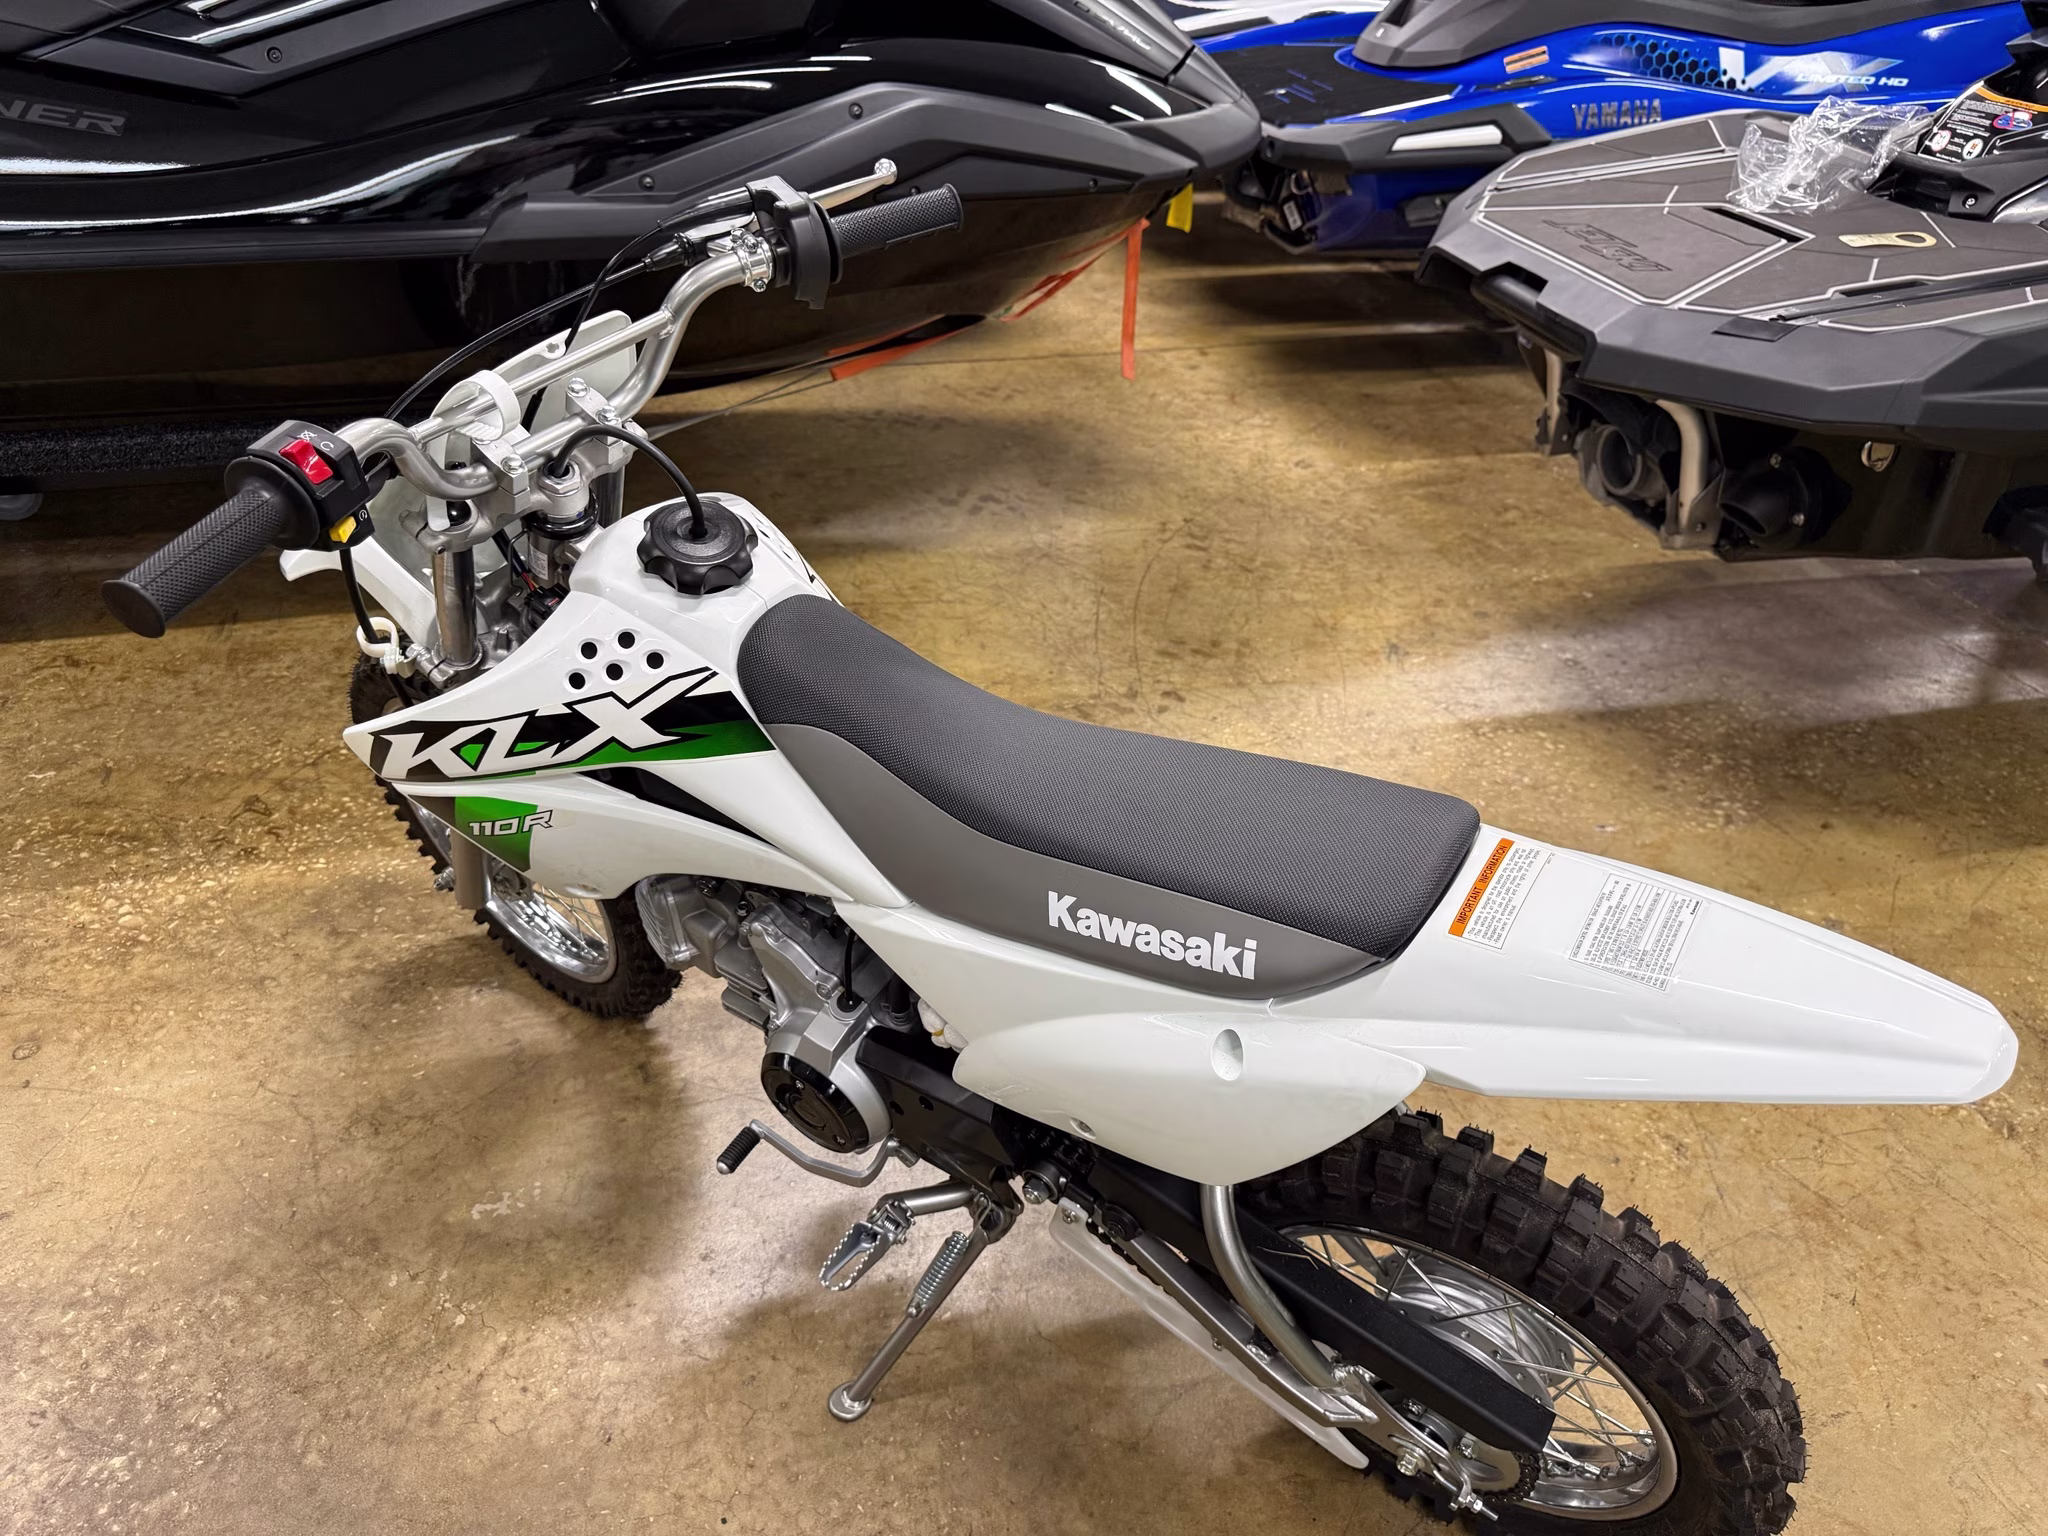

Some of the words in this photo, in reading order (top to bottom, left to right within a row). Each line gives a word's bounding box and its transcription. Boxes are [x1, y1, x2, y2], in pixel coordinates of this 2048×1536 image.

[1794, 73, 1876, 85] LIMITED
[1878, 76, 1910, 87] HD
[1572, 98, 1663, 131] YAMAHA
[378, 666, 720, 780] KLX
[468, 809, 555, 837] 110R
[1456, 886, 1483, 925] IMPORTANT
[1478, 845, 1508, 884] INFORMATION
[1048, 890, 1258, 981] Kawasaki
